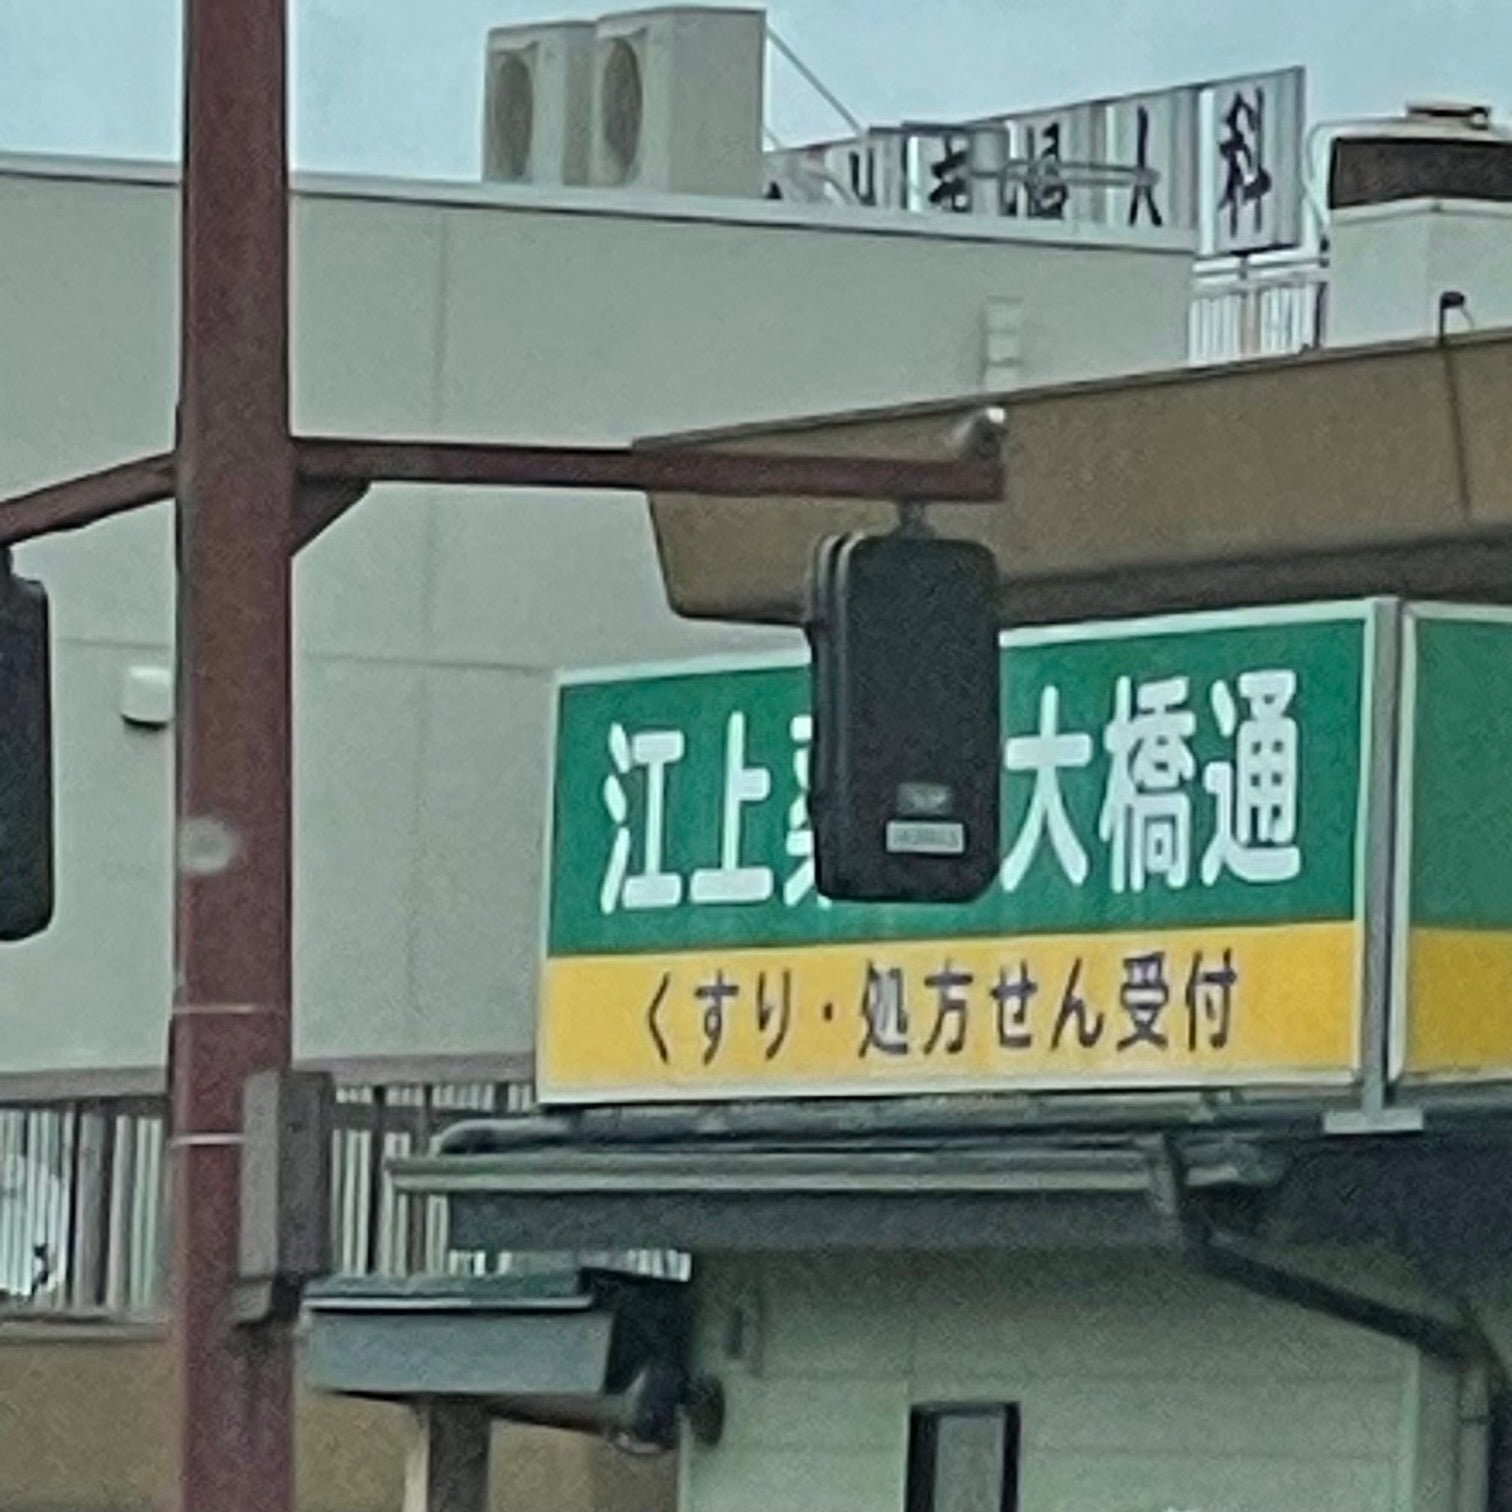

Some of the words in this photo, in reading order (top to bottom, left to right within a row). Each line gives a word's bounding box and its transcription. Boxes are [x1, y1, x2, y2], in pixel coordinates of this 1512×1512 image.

[602, 668, 1302, 913] 江上大橋通
[646, 947, 1238, 1065] くすり・処方せん受付
